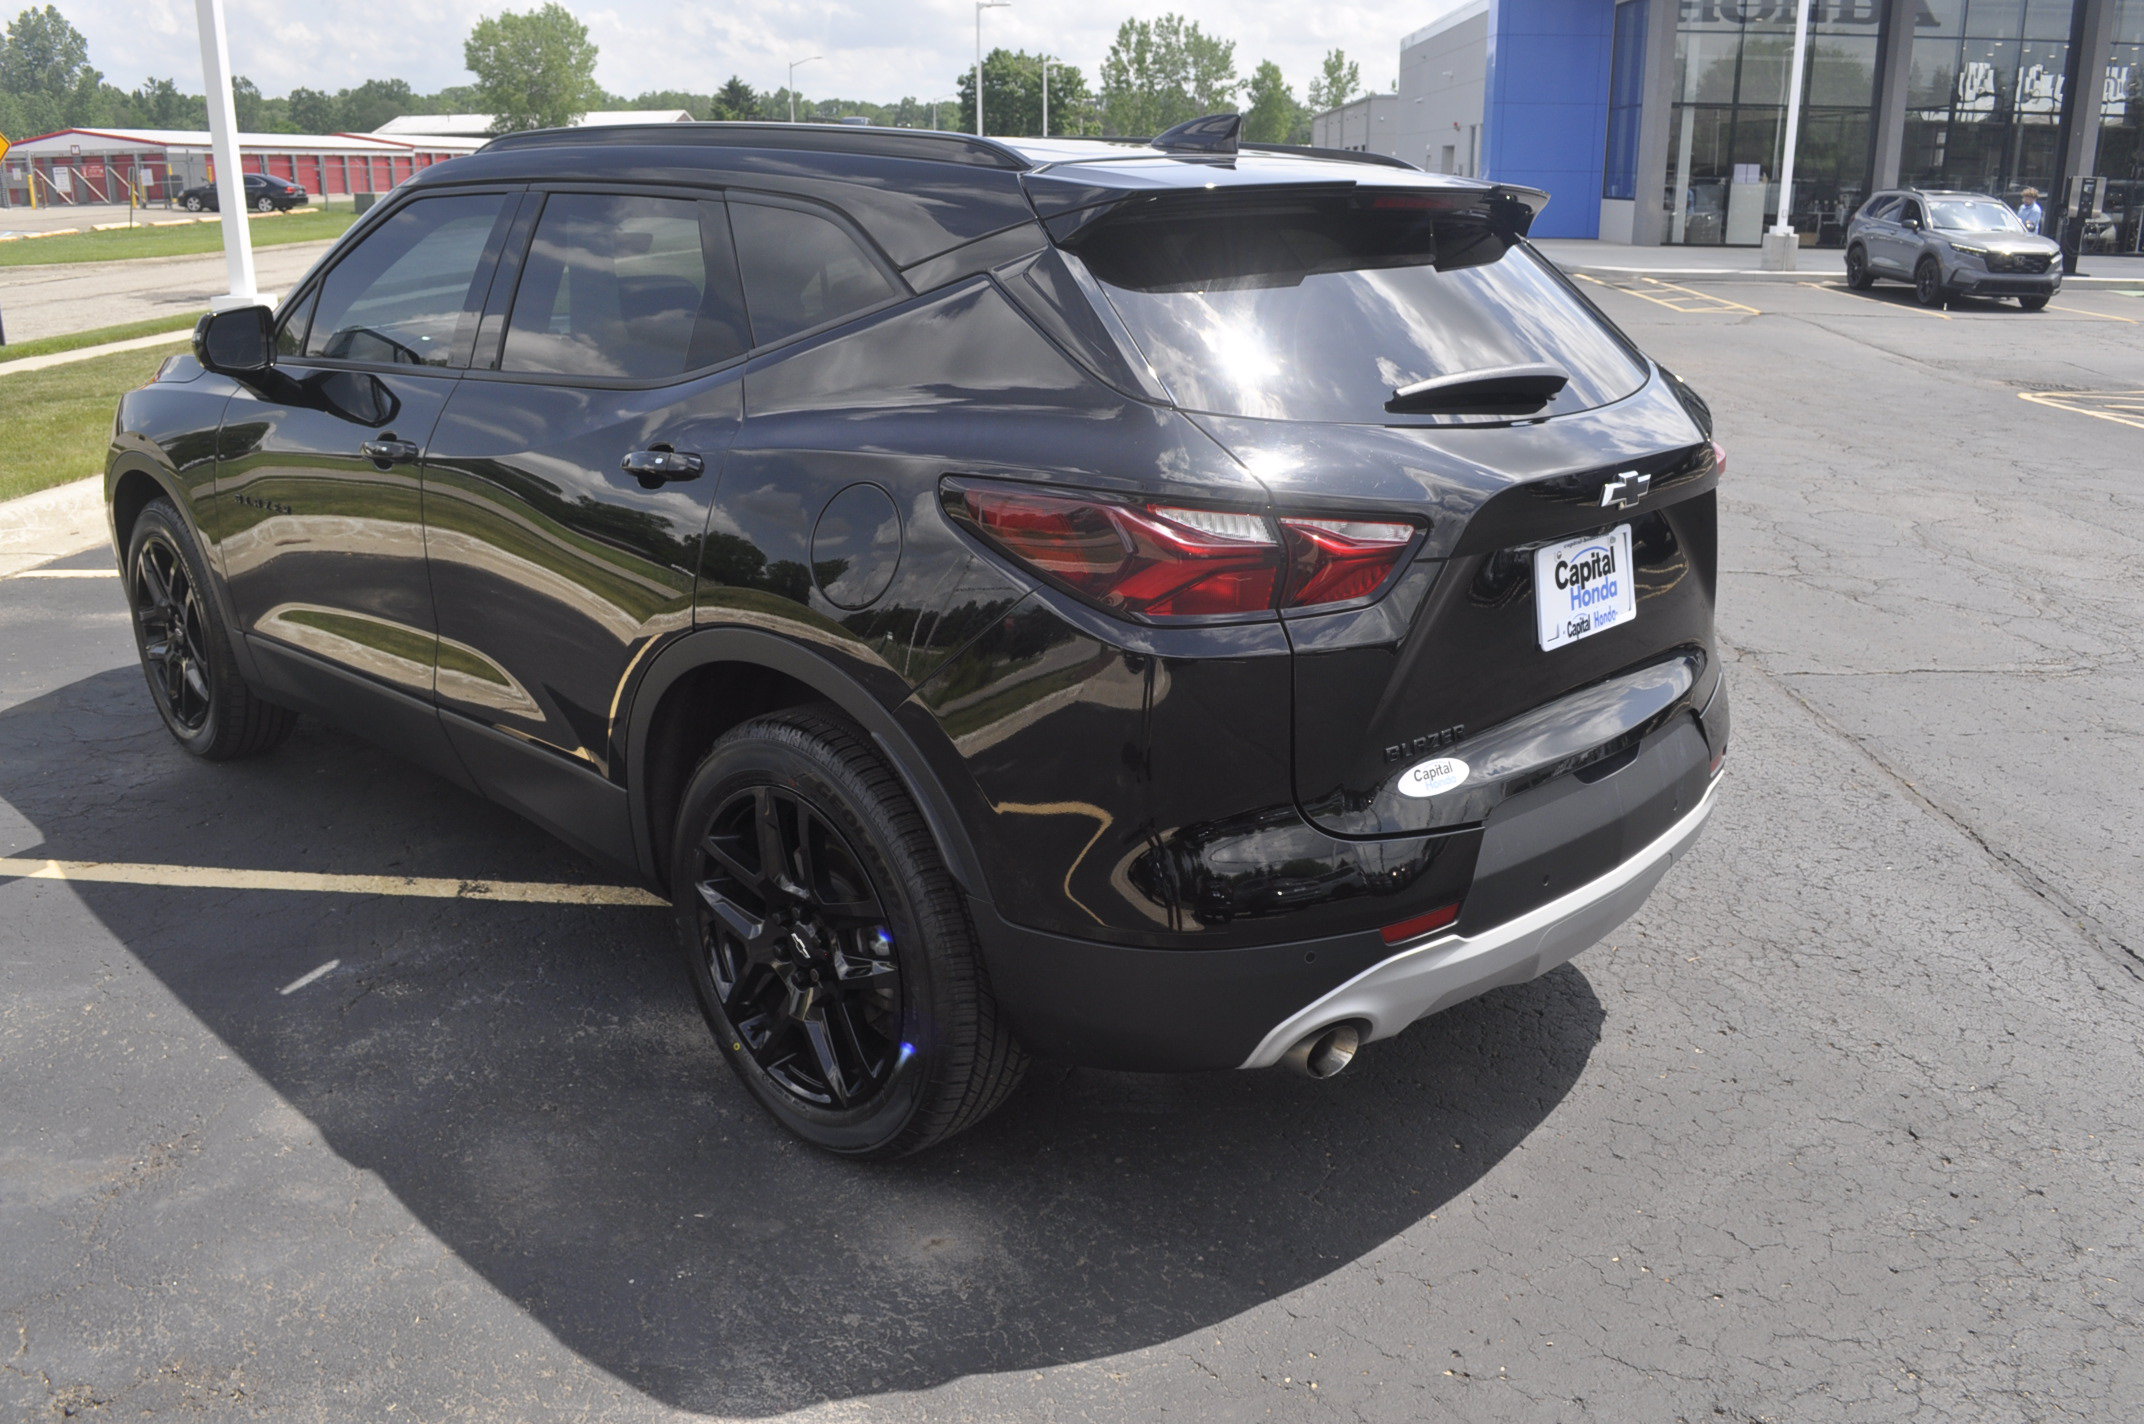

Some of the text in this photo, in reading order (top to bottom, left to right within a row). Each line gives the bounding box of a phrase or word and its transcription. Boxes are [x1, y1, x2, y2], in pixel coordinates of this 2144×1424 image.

[1678, 0, 1941, 27] HOND
[1555, 546, 1616, 590] Capital
[1570, 576, 1618, 611] Honda
[1567, 605, 1616, 639] Capital Honda
[1385, 724, 1464, 762] BLAZER
[1413, 761, 1453, 781] Capital
